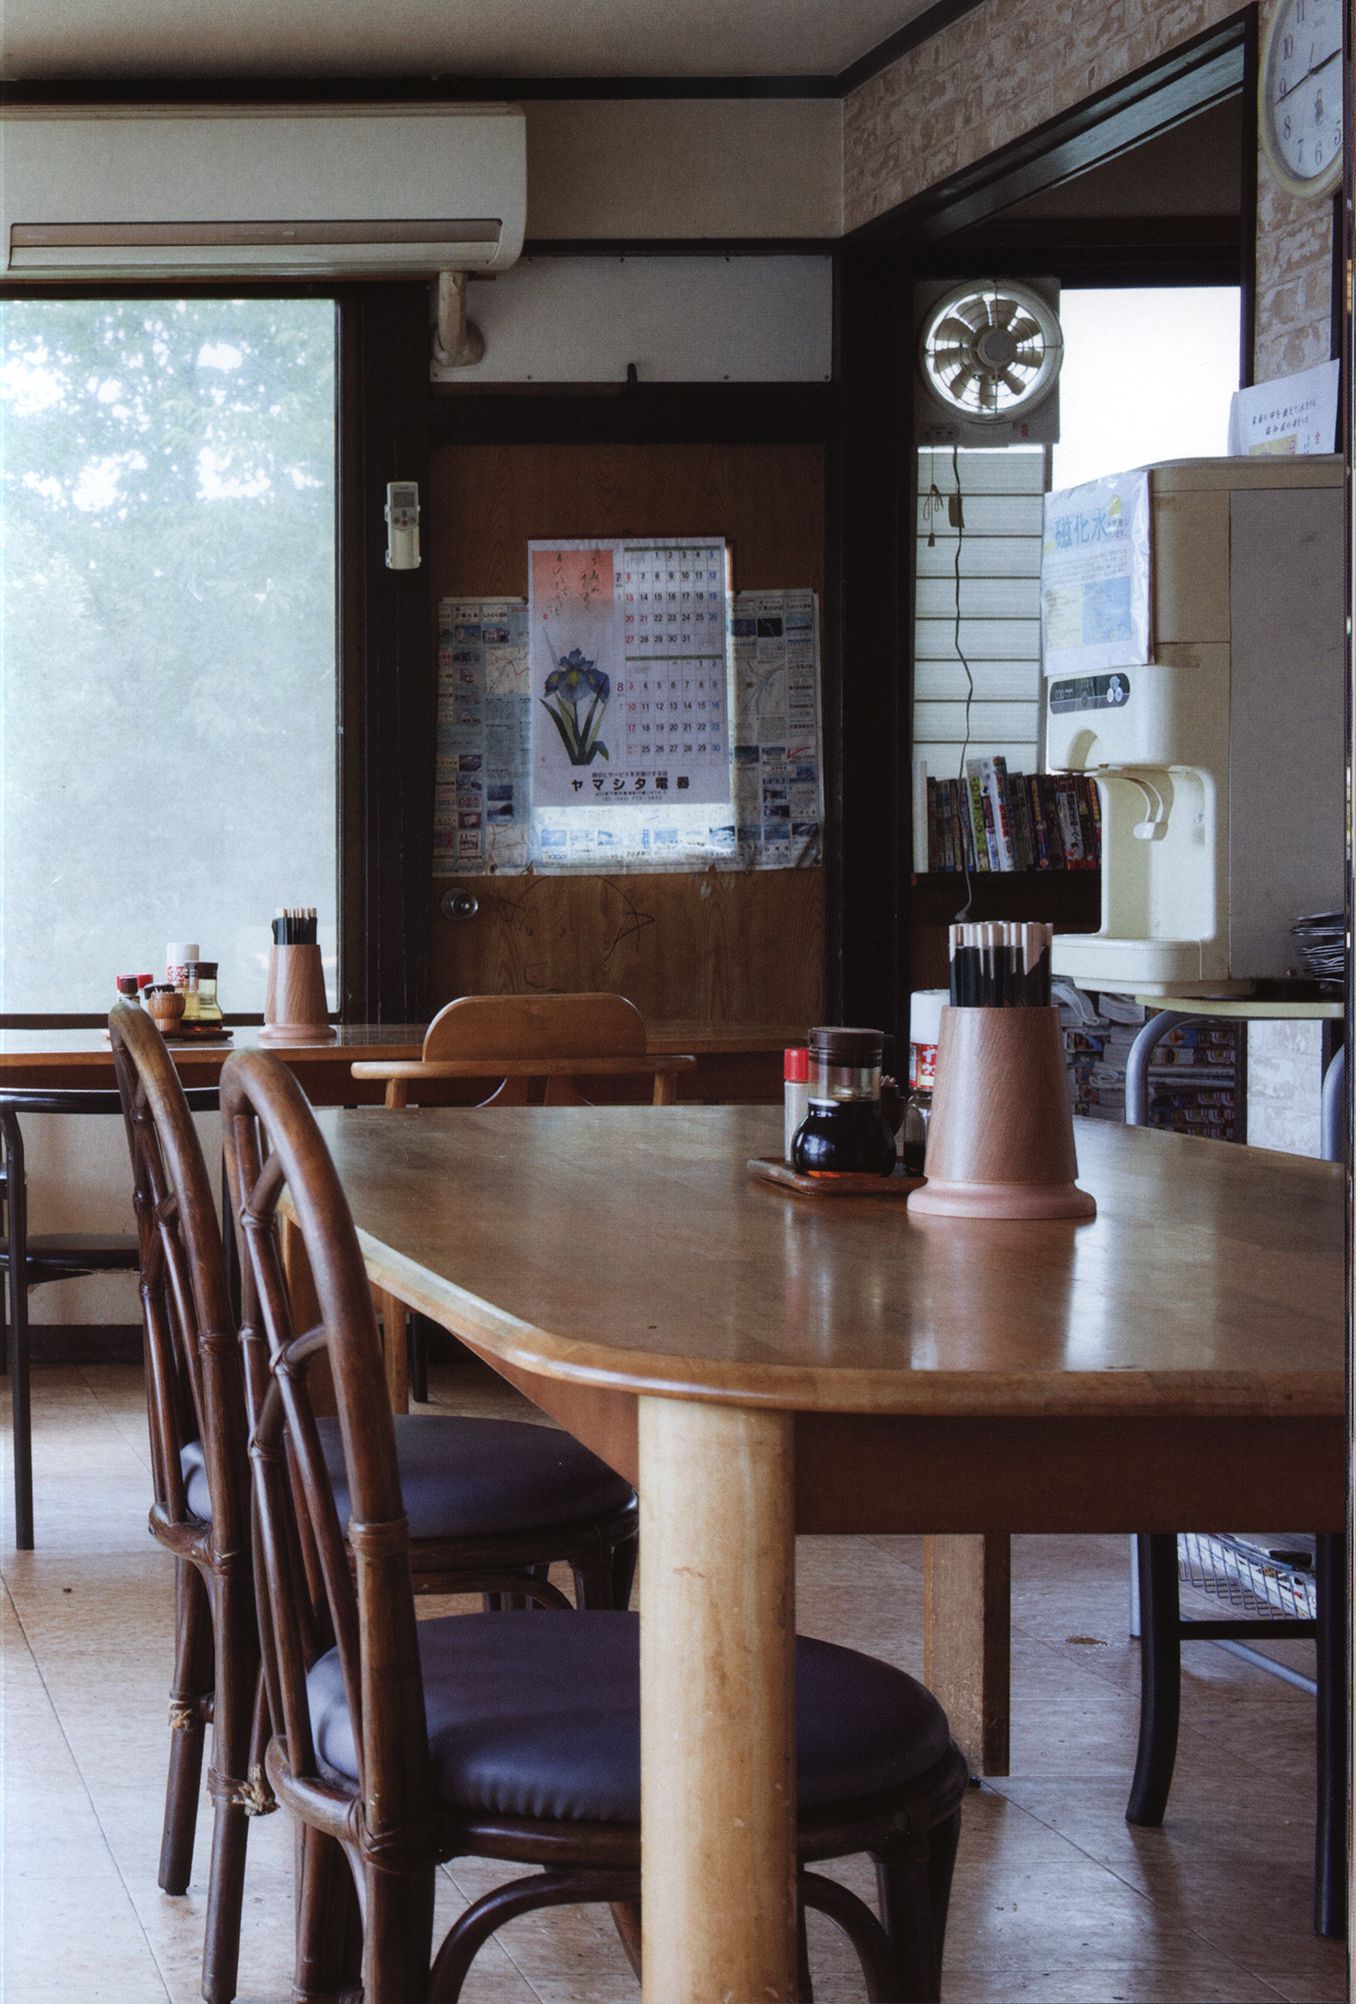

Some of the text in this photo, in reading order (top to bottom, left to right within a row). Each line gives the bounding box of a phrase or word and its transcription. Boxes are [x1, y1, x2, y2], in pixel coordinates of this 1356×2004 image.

[1283, 34, 1294, 61] 10
[1279, 78, 1287, 99] 9
[1284, 115, 1291, 140] 8
[1334, 120, 1342, 146] 5
[1297, 139, 1305, 164] 7
[1314, 141, 1323, 166] 6
[1055, 508, 1108, 548] 磁化水
[655, 551, 659, 559] 1
[668, 551, 673, 559] 2
[615, 573, 622, 583] 7
[669, 572, 673, 580] 9
[625, 636, 634, 644] 27
[639, 635, 649, 643] 28
[654, 635, 663, 643] 29
[712, 659, 717, 667] 2
[616, 682, 624, 692] 8
[697, 723, 706, 731] 22
[655, 745, 664, 753] 26
[711, 744, 720, 752] 30
